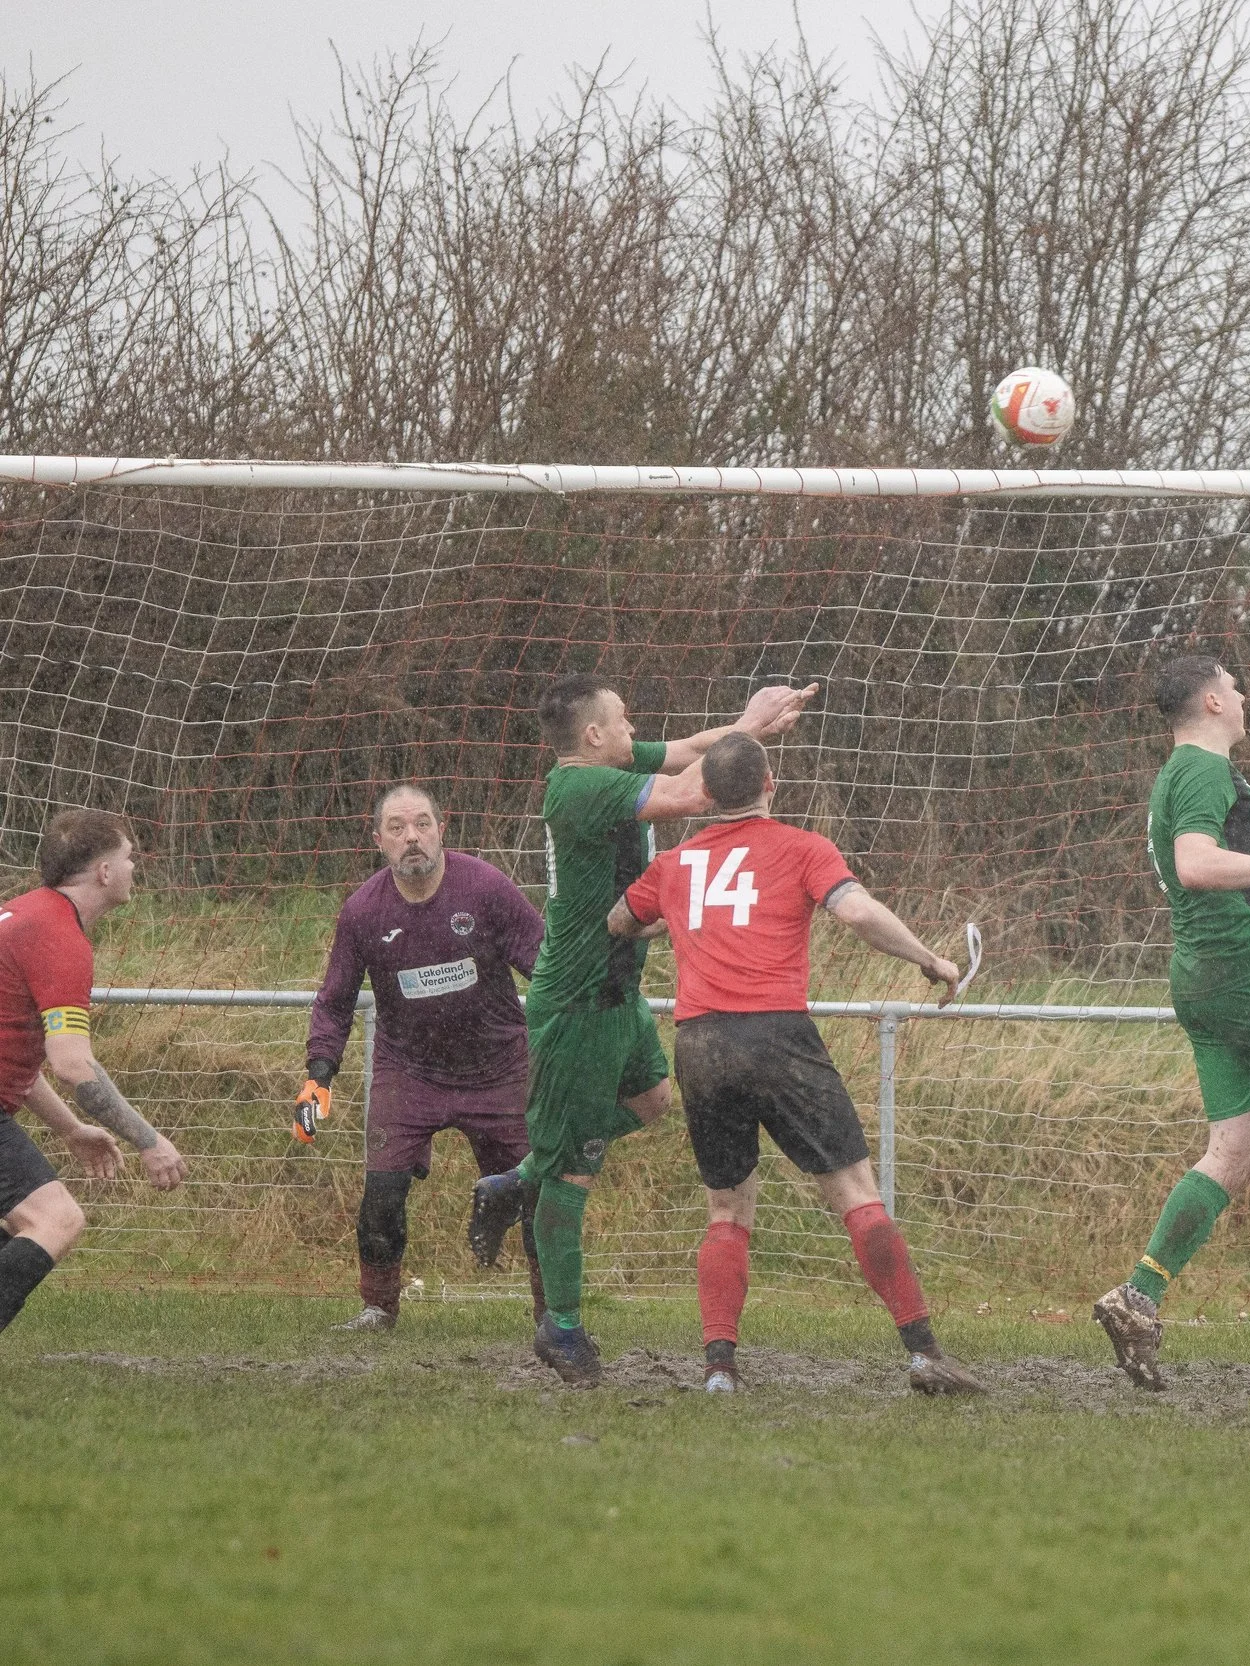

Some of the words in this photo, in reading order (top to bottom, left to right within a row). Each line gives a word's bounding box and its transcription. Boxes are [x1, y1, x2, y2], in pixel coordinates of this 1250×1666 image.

[679, 847, 759, 931] 14
[418, 962, 464, 979] Lakeland
[420, 968, 476, 987] Verandahs
[48, 1011, 63, 1031] C
